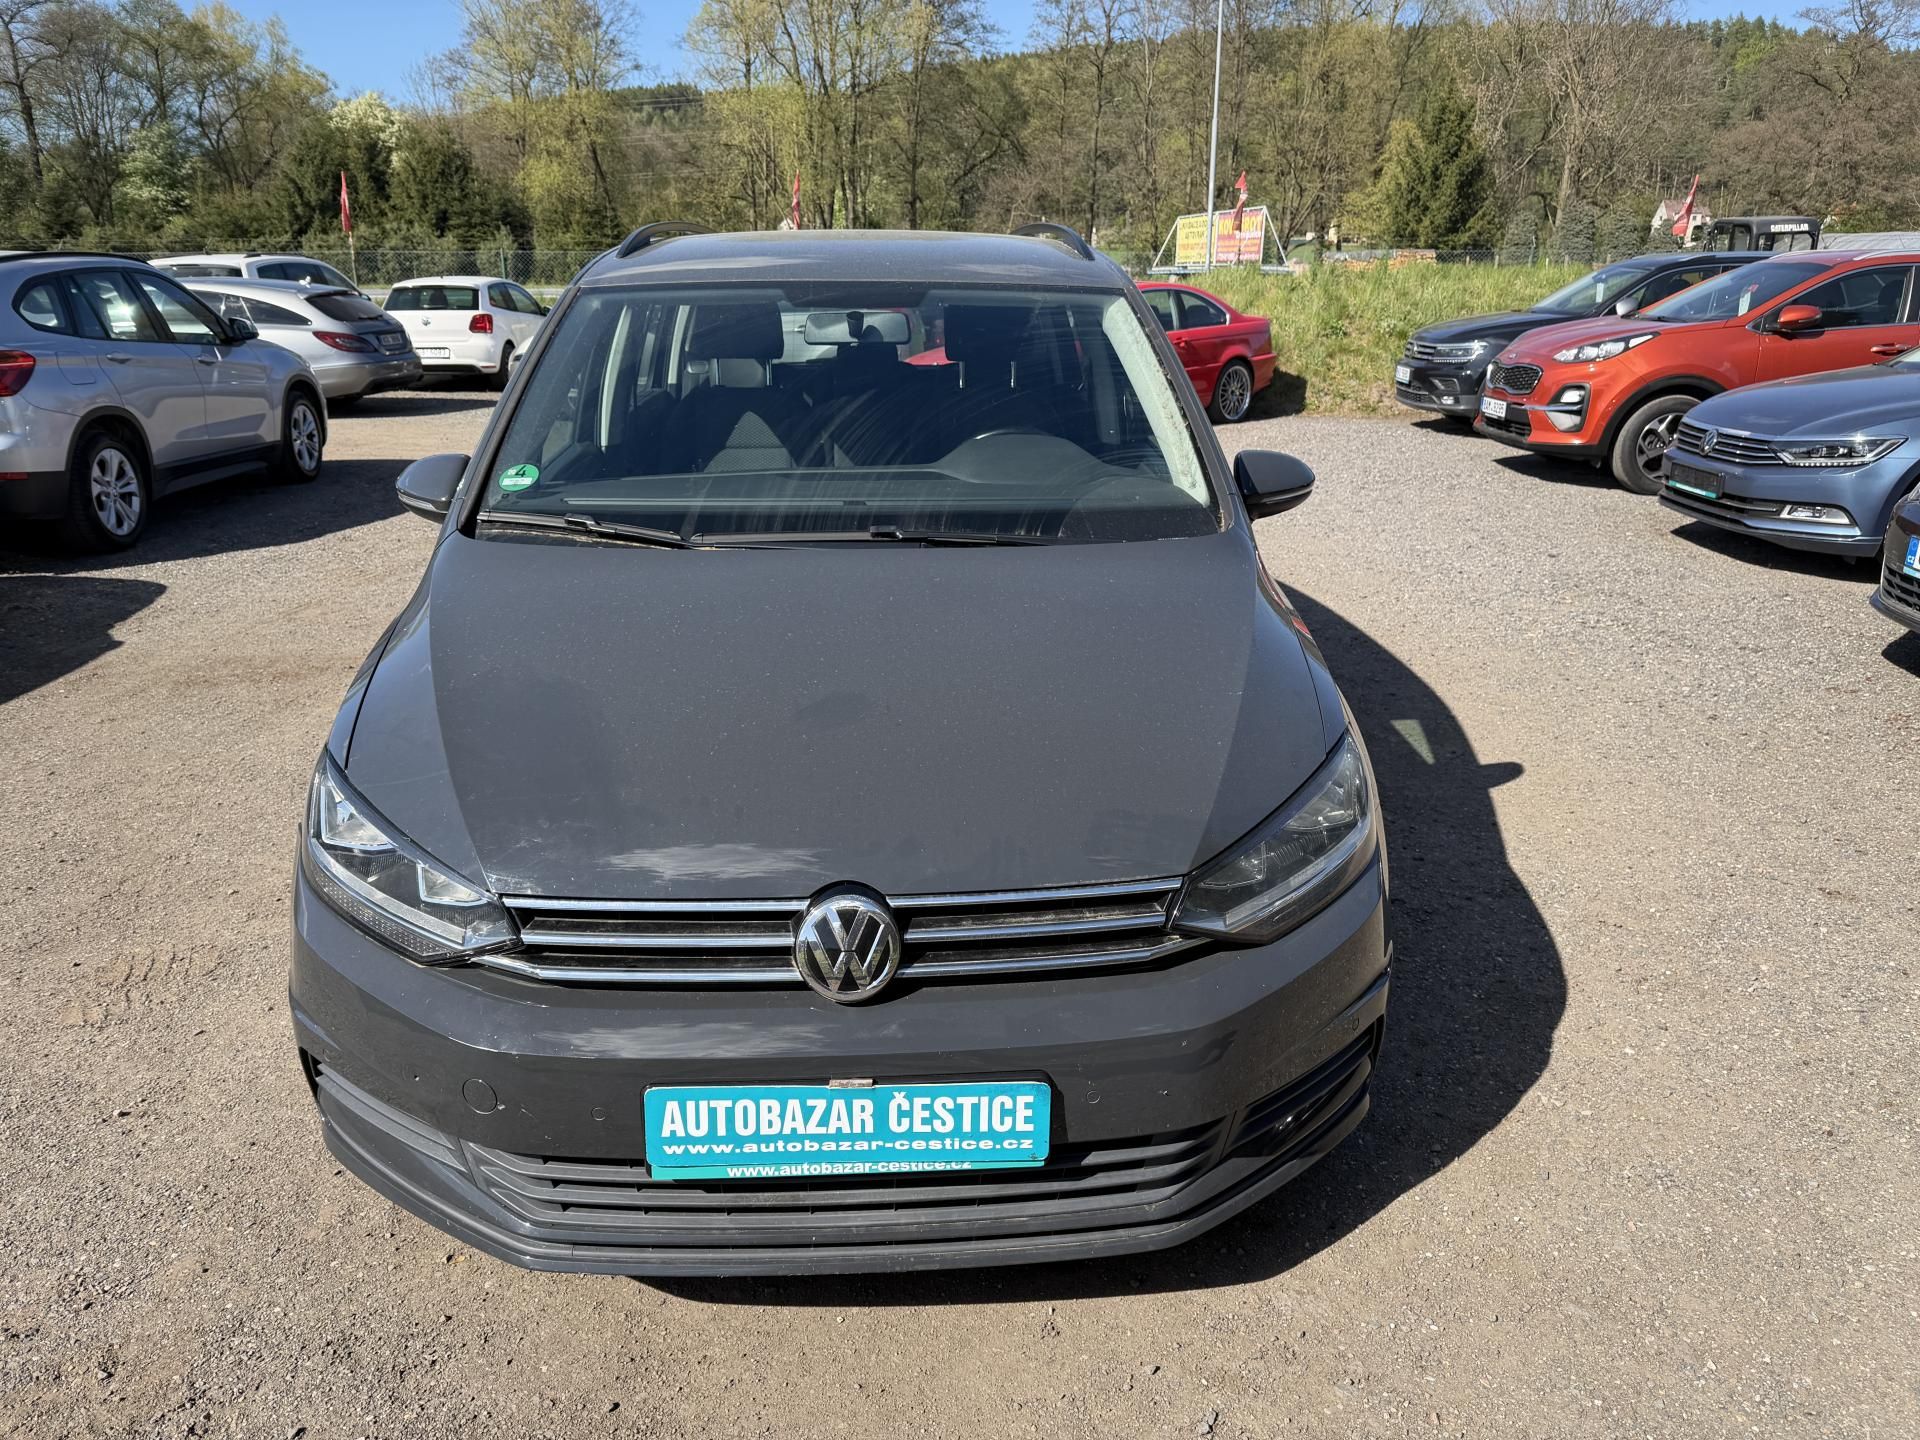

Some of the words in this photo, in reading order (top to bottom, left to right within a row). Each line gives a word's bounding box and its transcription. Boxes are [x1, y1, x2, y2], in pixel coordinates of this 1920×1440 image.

[1770, 223, 1809, 233] CATERPILLAR
[514, 465, 527, 477] 4
[661, 1098, 874, 1137] AUTOBAZAR
[889, 1091, 1034, 1134] ČESTICE
[662, 1138, 1033, 1155] www.autobazar-cestice.cz
